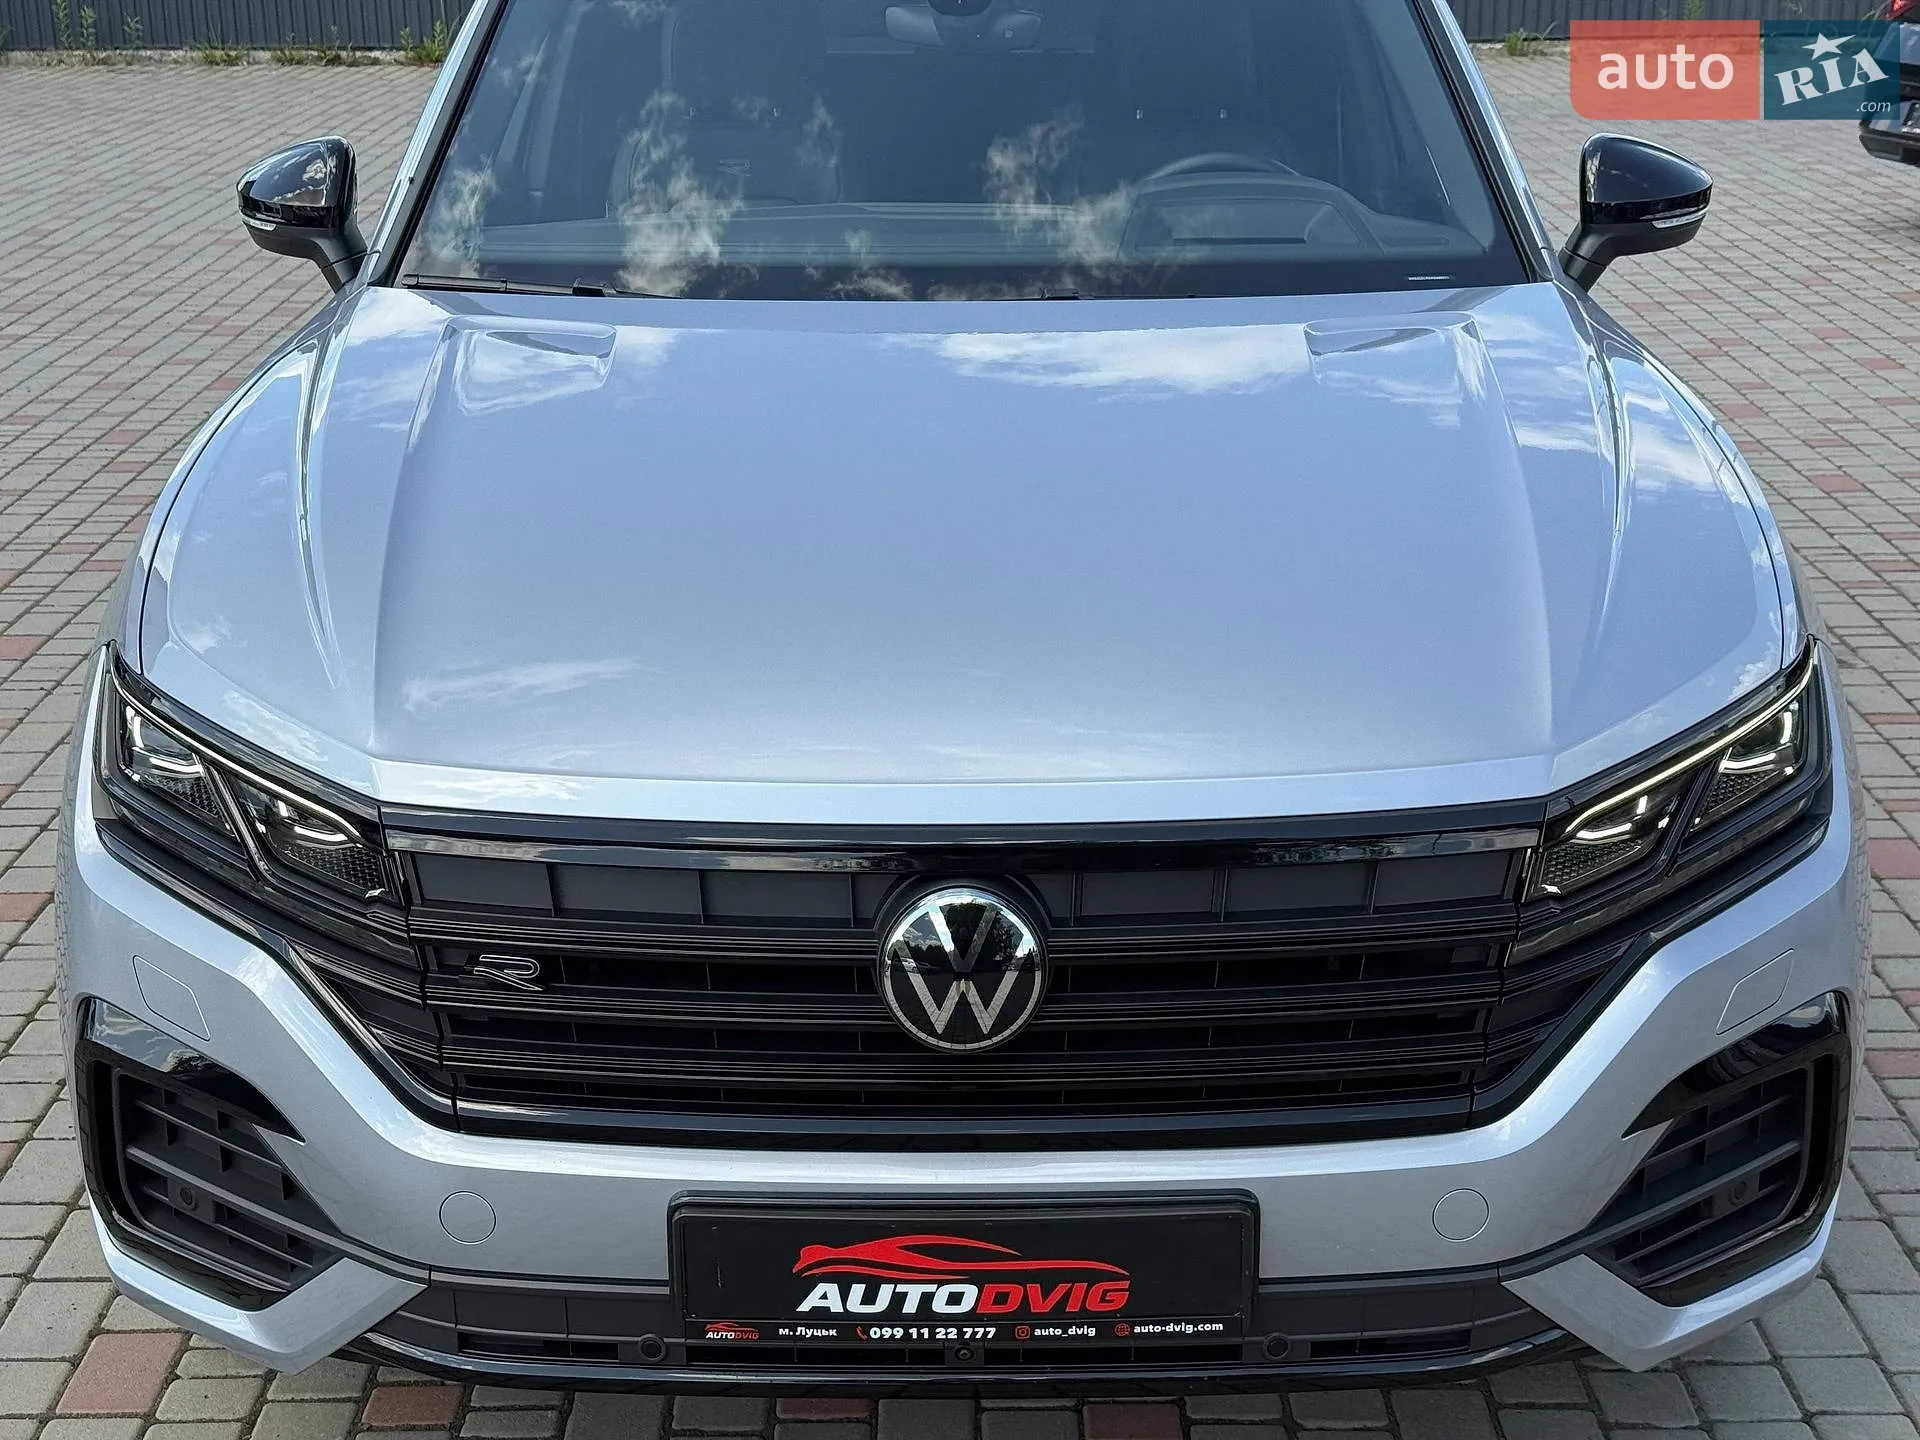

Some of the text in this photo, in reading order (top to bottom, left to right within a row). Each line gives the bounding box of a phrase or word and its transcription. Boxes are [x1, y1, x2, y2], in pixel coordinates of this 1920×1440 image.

[473, 954, 544, 991] R
[796, 1280, 1131, 1314] AUTODVIG
[778, 1326, 838, 1338] м. Луцьк
[869, 1327, 997, 1339] 099 11 22 777
[1033, 1325, 1096, 1337] auto_dvig
[1133, 1322, 1224, 1335] auto-dvig.com
[705, 1331, 760, 1340] AUTODVIG
